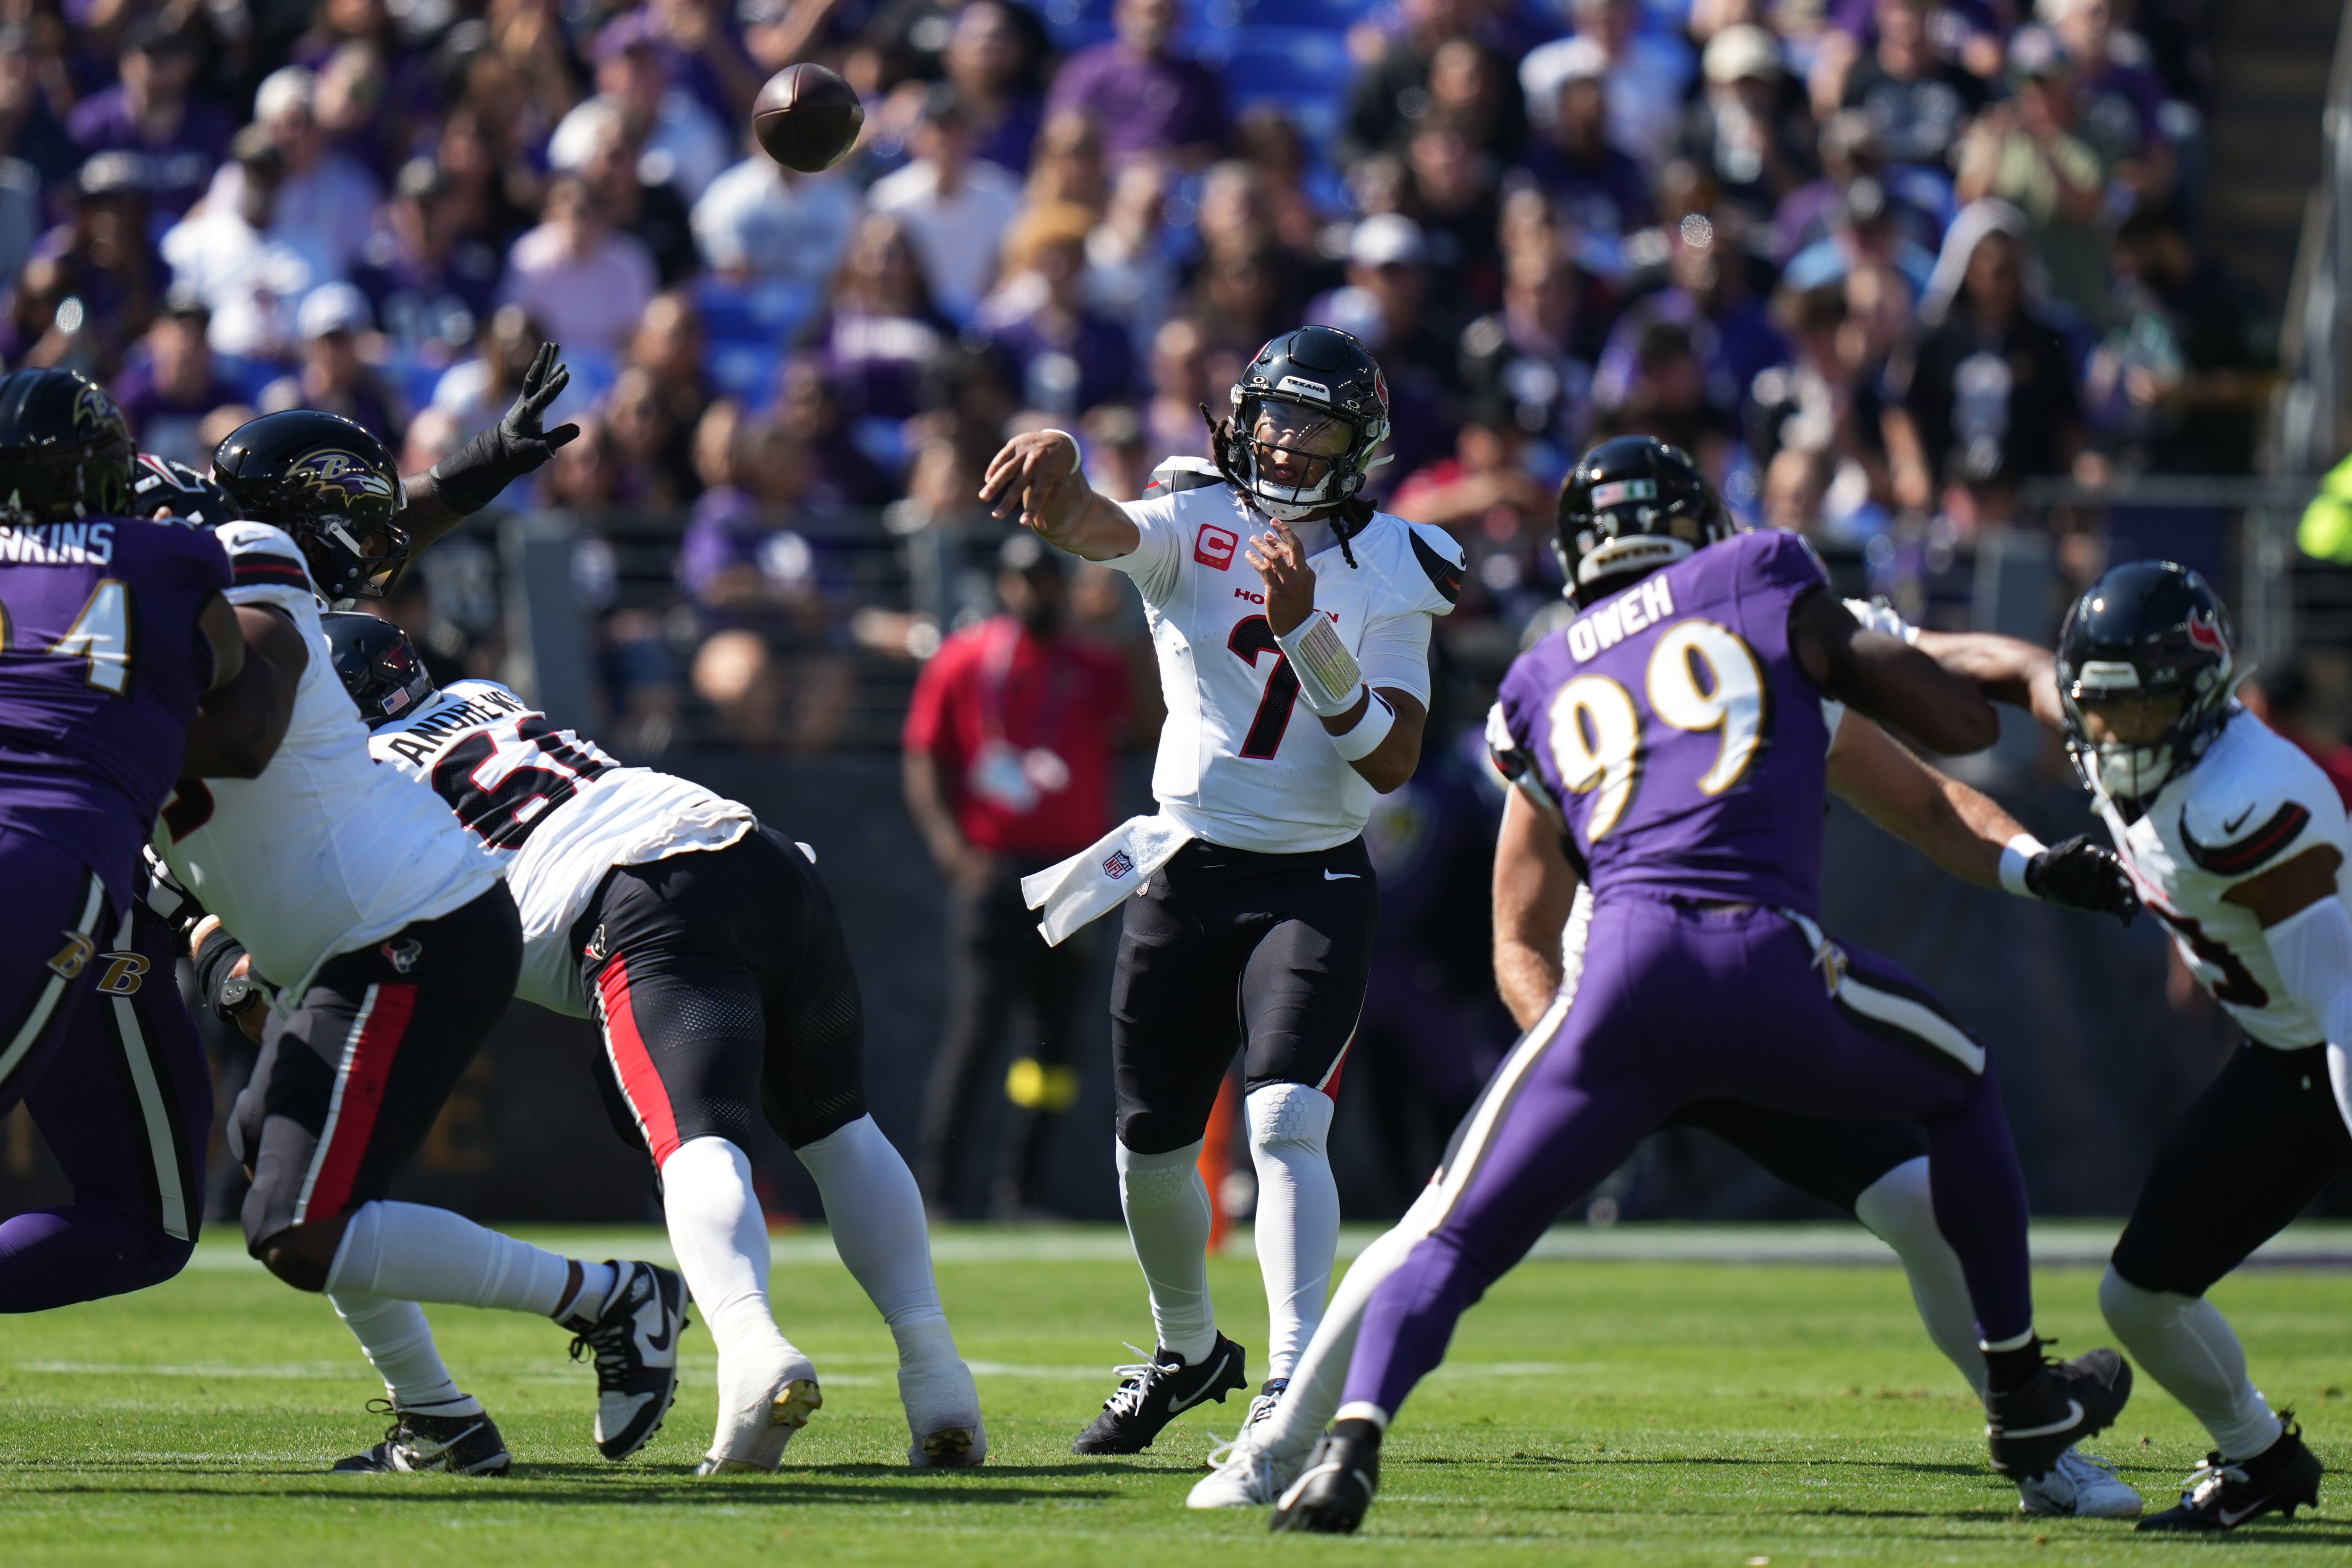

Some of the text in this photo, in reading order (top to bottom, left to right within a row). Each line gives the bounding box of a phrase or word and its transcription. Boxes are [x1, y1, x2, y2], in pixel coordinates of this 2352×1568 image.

[1286, 378, 1326, 394] TEXANS
[1198, 527, 1235, 560] C
[0, 578, 131, 697] 4
[1567, 574, 1675, 663] OWEH
[1549, 618, 1764, 843] 99
[1105, 858, 1123, 878] NFL
[95, 952, 150, 995] B
